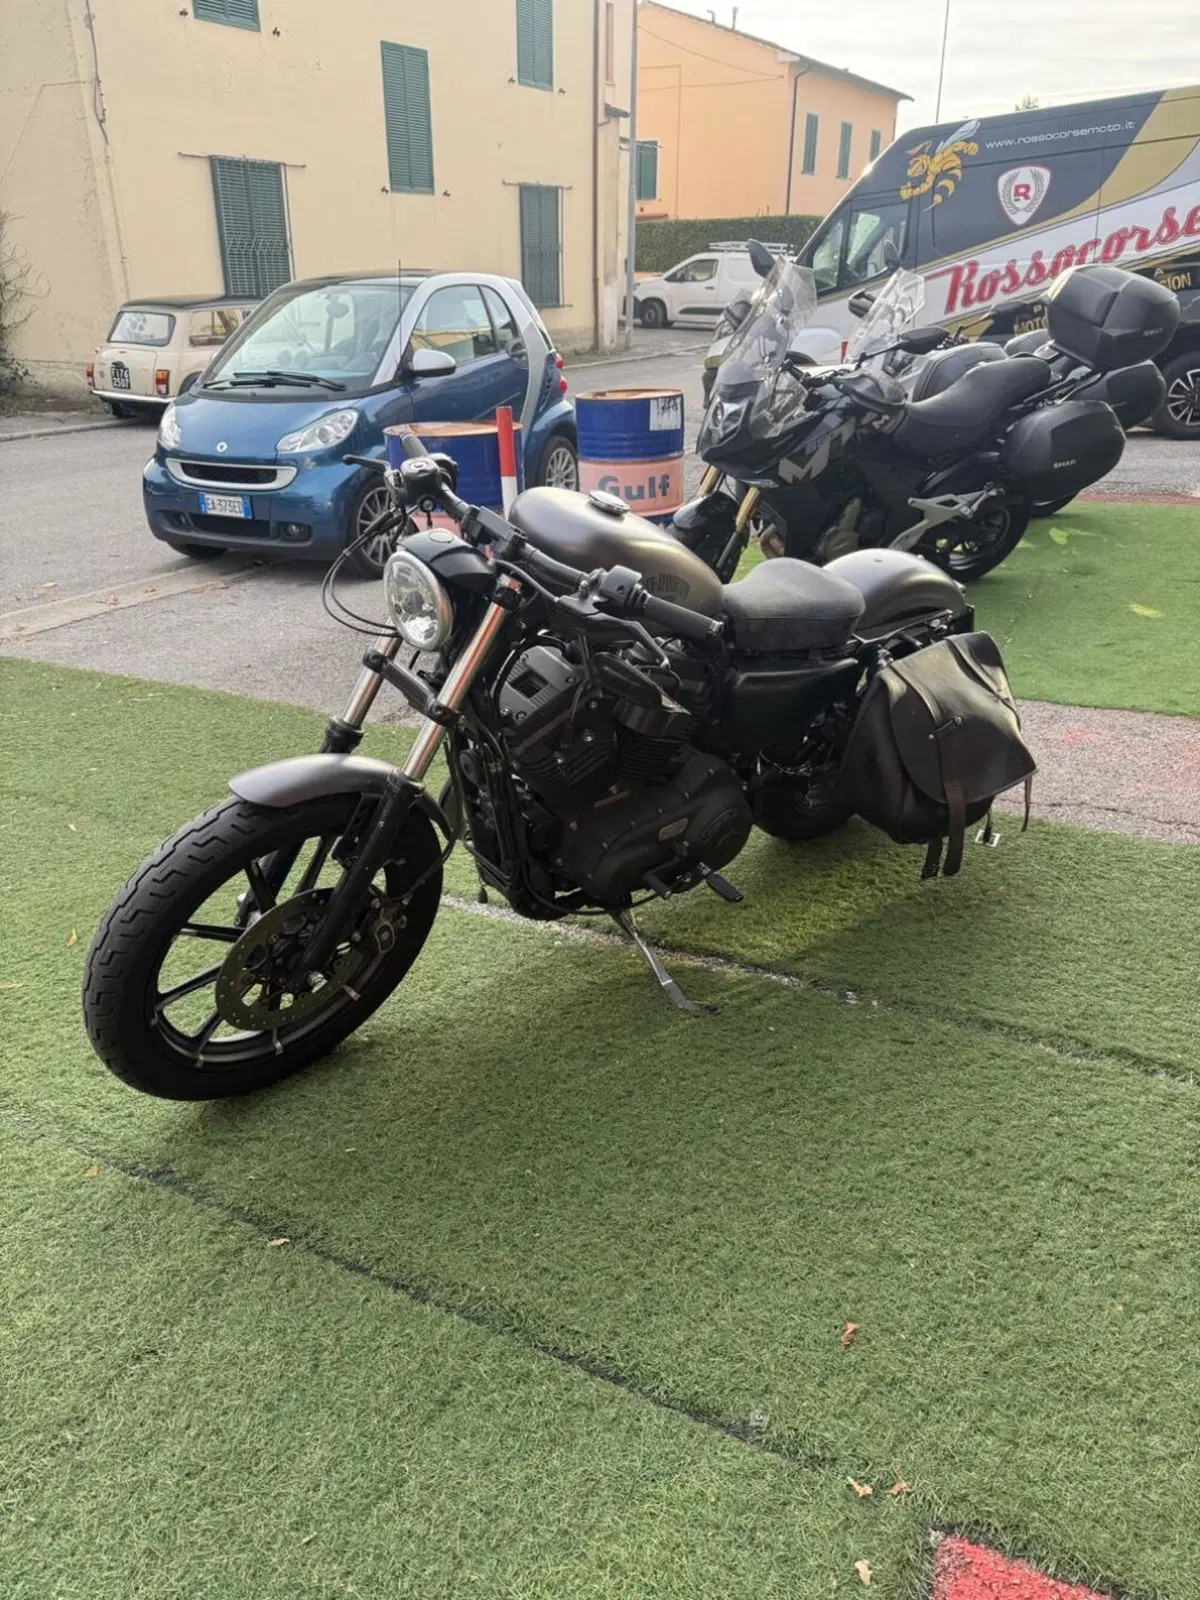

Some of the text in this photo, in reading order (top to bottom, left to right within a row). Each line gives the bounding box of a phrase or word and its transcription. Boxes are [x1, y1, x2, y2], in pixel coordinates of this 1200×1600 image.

[985, 120, 1136, 149] www.rossocorsemoto.it
[1013, 183, 1031, 200] R
[597, 474, 671, 501] Gulf
